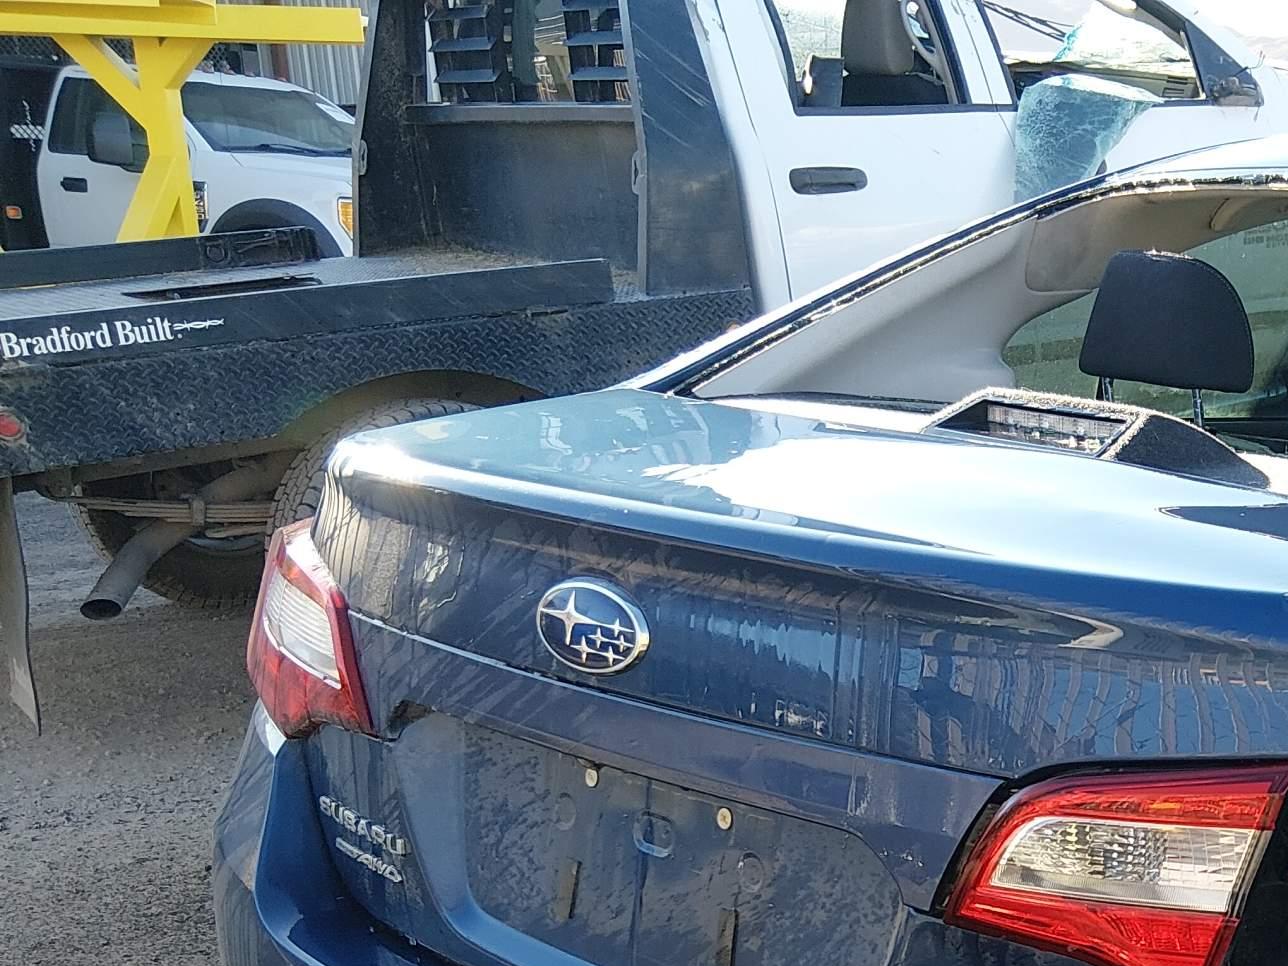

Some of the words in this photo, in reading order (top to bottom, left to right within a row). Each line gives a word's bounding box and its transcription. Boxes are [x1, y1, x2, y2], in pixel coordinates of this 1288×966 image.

[0, 322, 113, 360] Bradford
[319, 795, 406, 855] SUBARU
[356, 853, 402, 883] AWD
